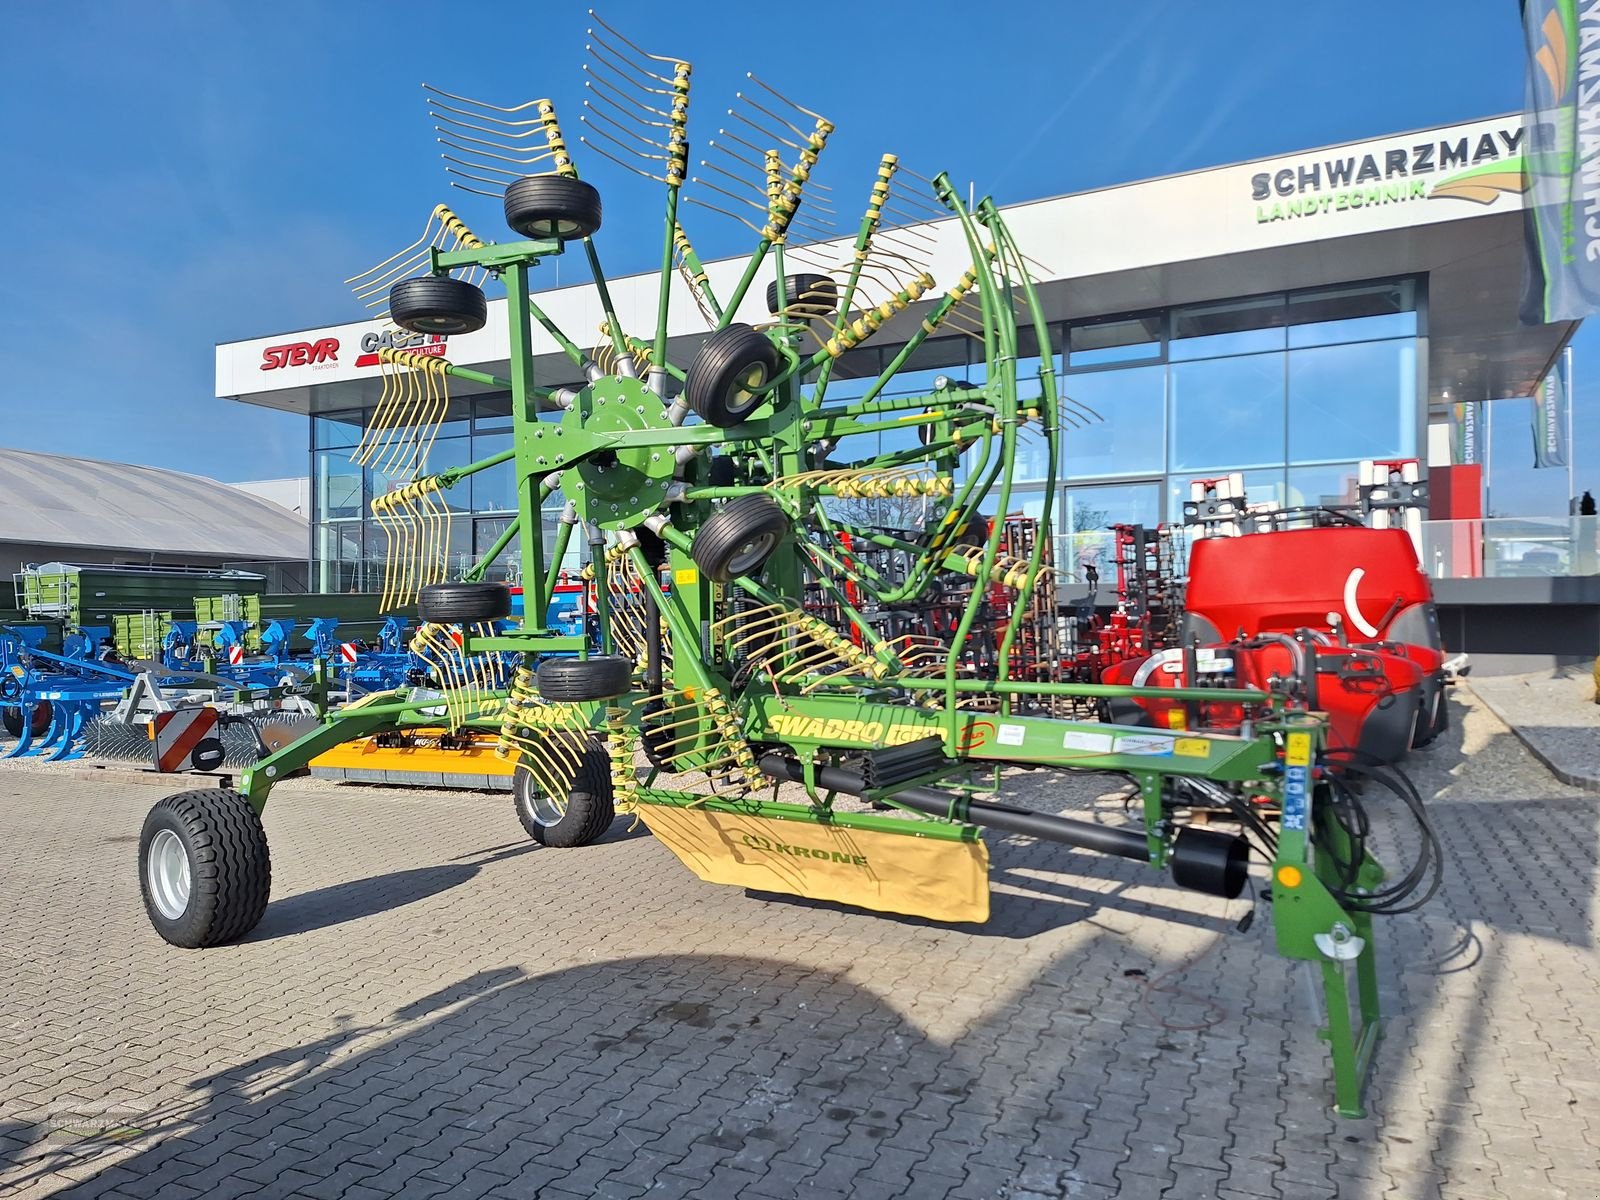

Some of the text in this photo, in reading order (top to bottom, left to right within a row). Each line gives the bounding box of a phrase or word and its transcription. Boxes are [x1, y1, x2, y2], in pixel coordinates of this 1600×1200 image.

[1256, 179, 1428, 224] LANDTECHNIK
[260, 337, 341, 371] STEYR
[767, 714, 885, 743] SWADRO
[774, 842, 868, 867] KRONE
